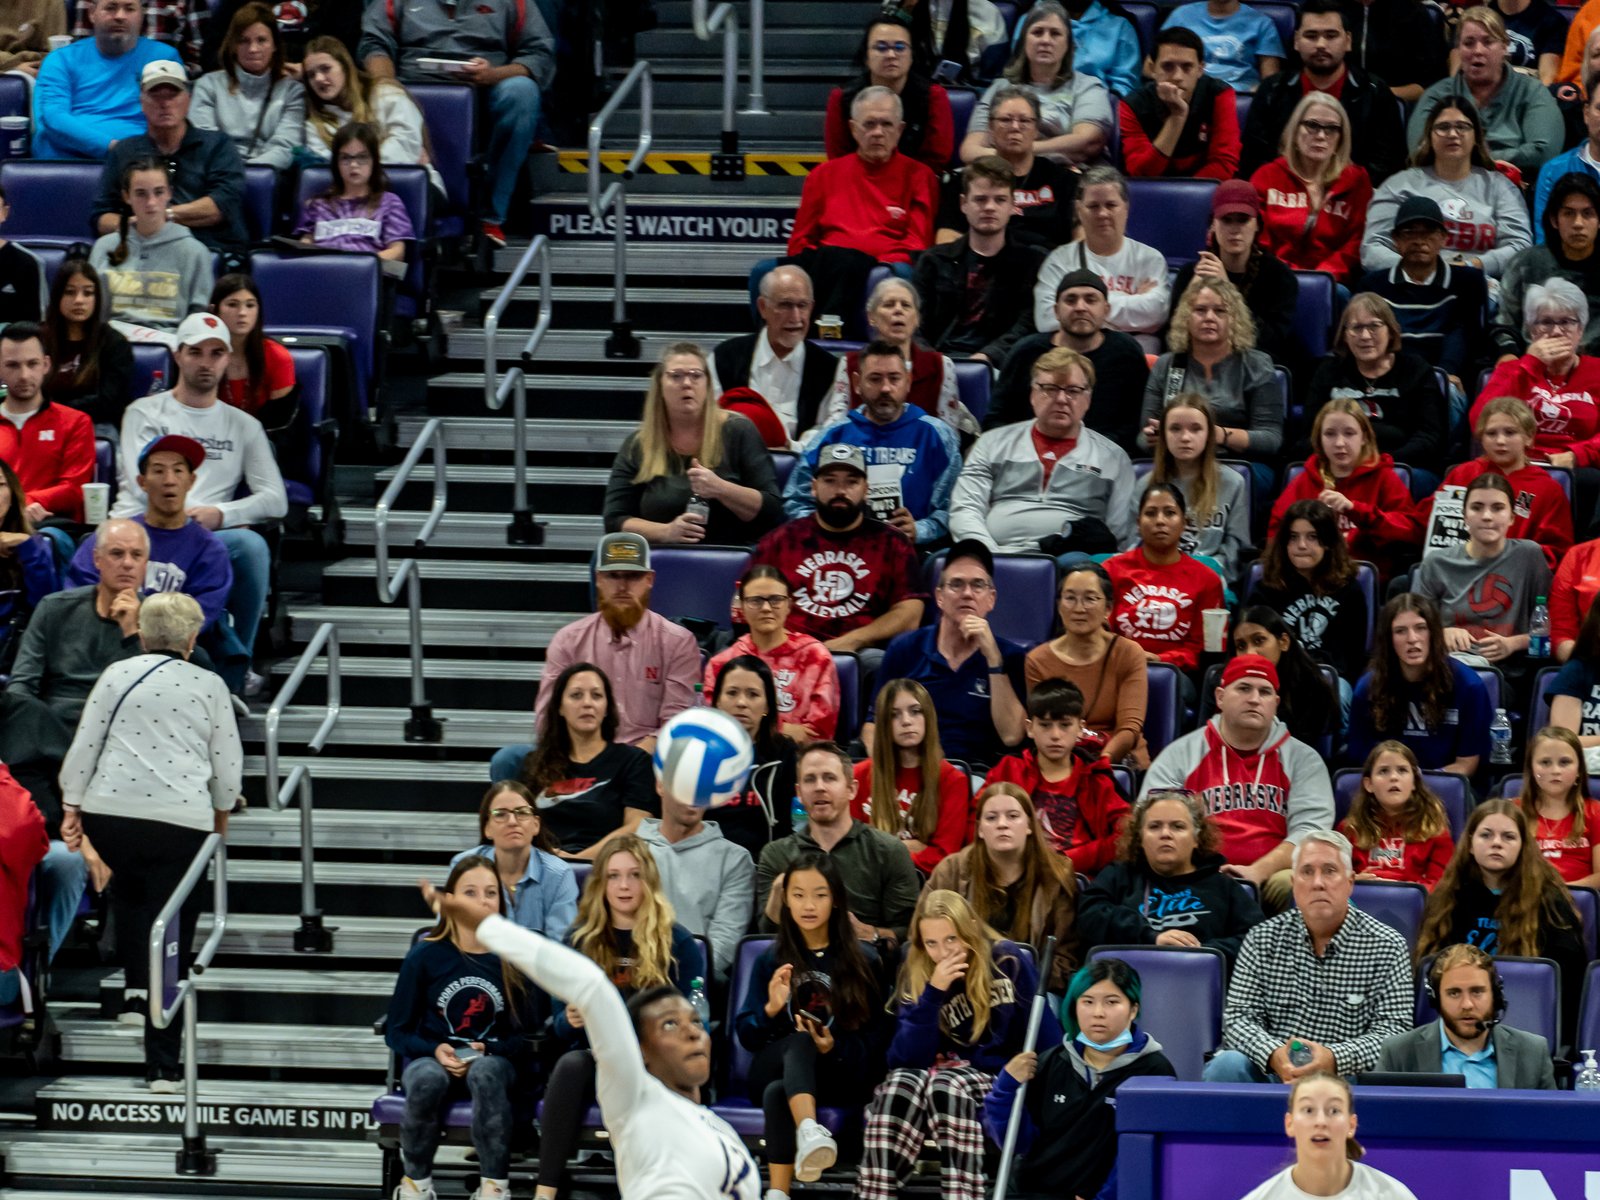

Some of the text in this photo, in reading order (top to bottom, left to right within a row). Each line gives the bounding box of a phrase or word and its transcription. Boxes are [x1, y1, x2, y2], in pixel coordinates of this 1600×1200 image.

[550, 213, 633, 236] PLEASE
[637, 215, 714, 240] WATCH
[719, 217, 777, 239] YOUR
[795, 551, 871, 581] NEBRASKA
[793, 587, 871, 618] VOLLEYBALL
[1202, 782, 1288, 817] NEBRASKA
[437, 980, 461, 1009] SPORTS
[53, 1103, 84, 1121] NO
[88, 1104, 162, 1123] ACCESS
[234, 1107, 297, 1127] GAME
[301, 1109, 319, 1127] IS
[324, 1110, 346, 1129] IN
